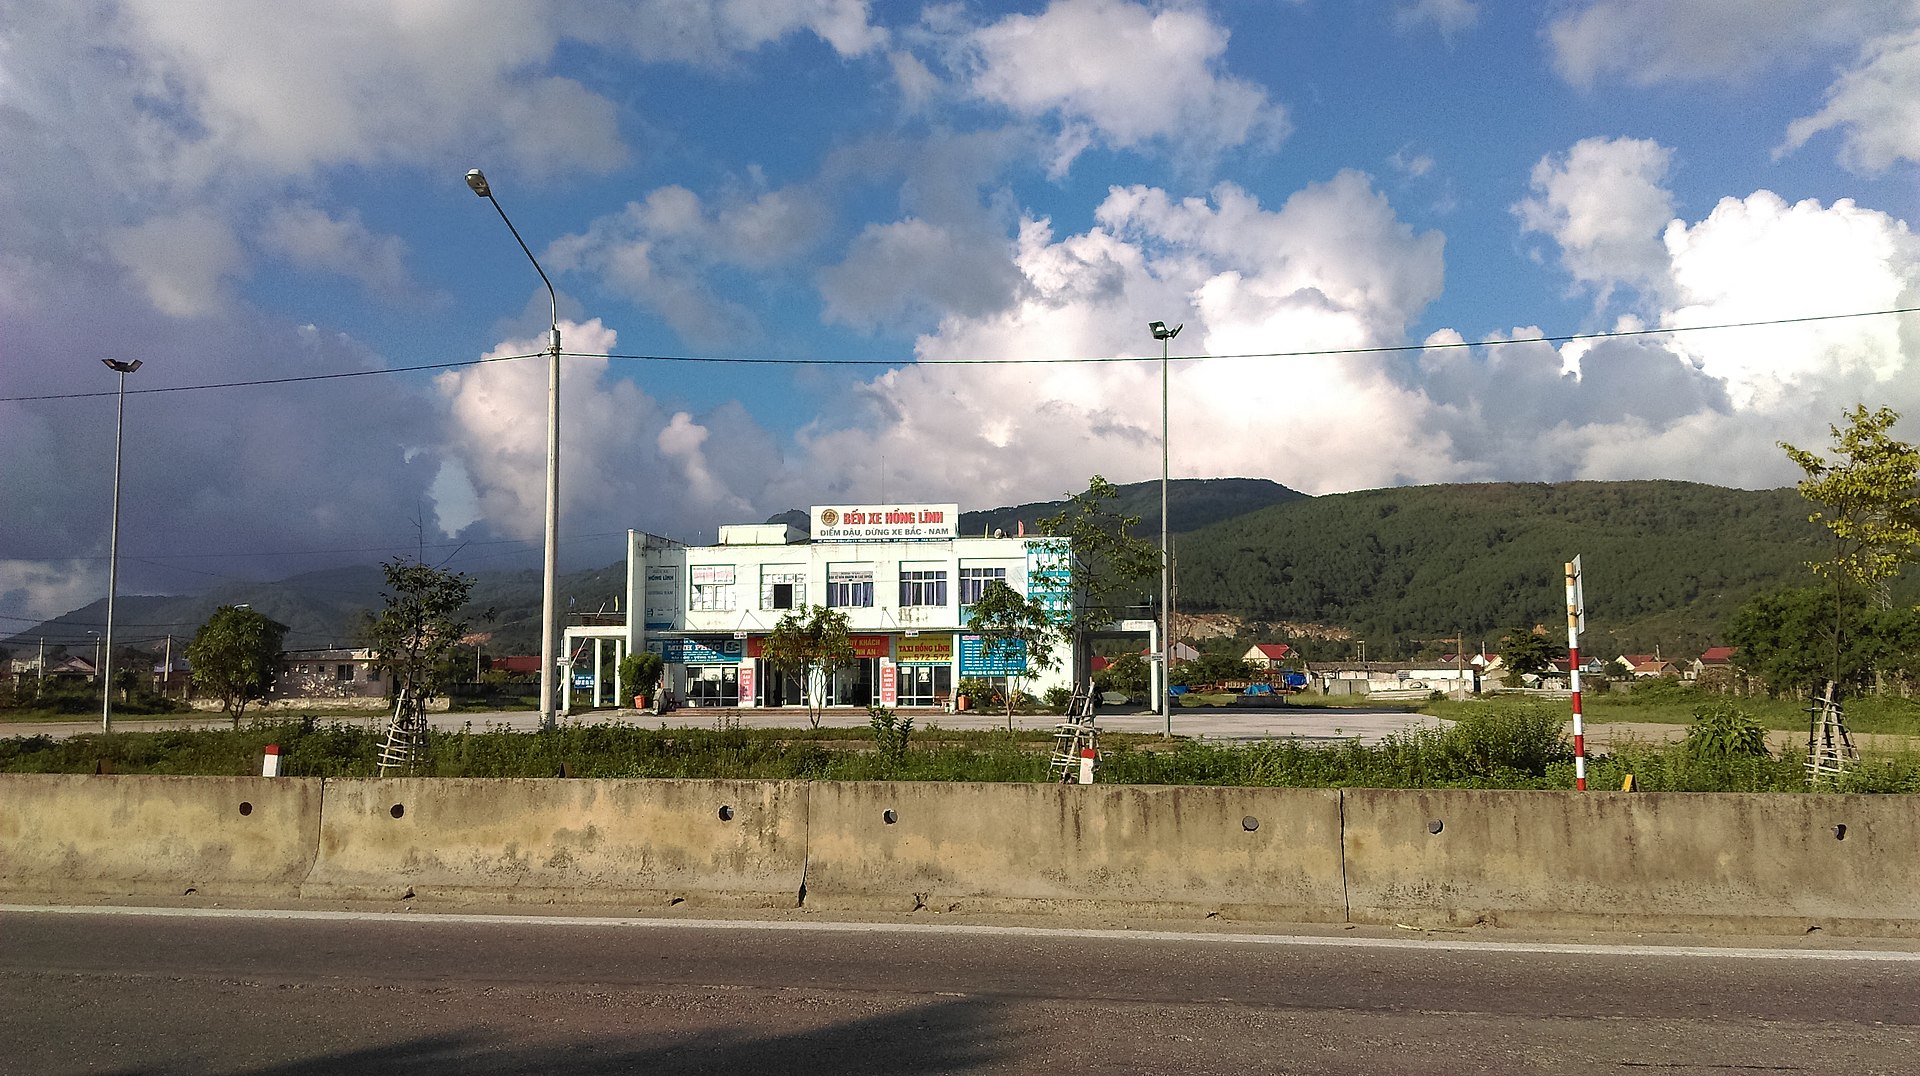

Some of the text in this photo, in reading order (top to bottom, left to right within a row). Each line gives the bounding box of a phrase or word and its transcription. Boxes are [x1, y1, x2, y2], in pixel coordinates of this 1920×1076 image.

[843, 508, 943, 525] BẾN XE HỒNG LĨNH
[891, 528, 903, 536] XE
[904, 525, 922, 536] BẮC
[898, 645, 914, 653] TAXI
[914, 653, 931, 661] 572
[933, 653, 950, 661] 572
